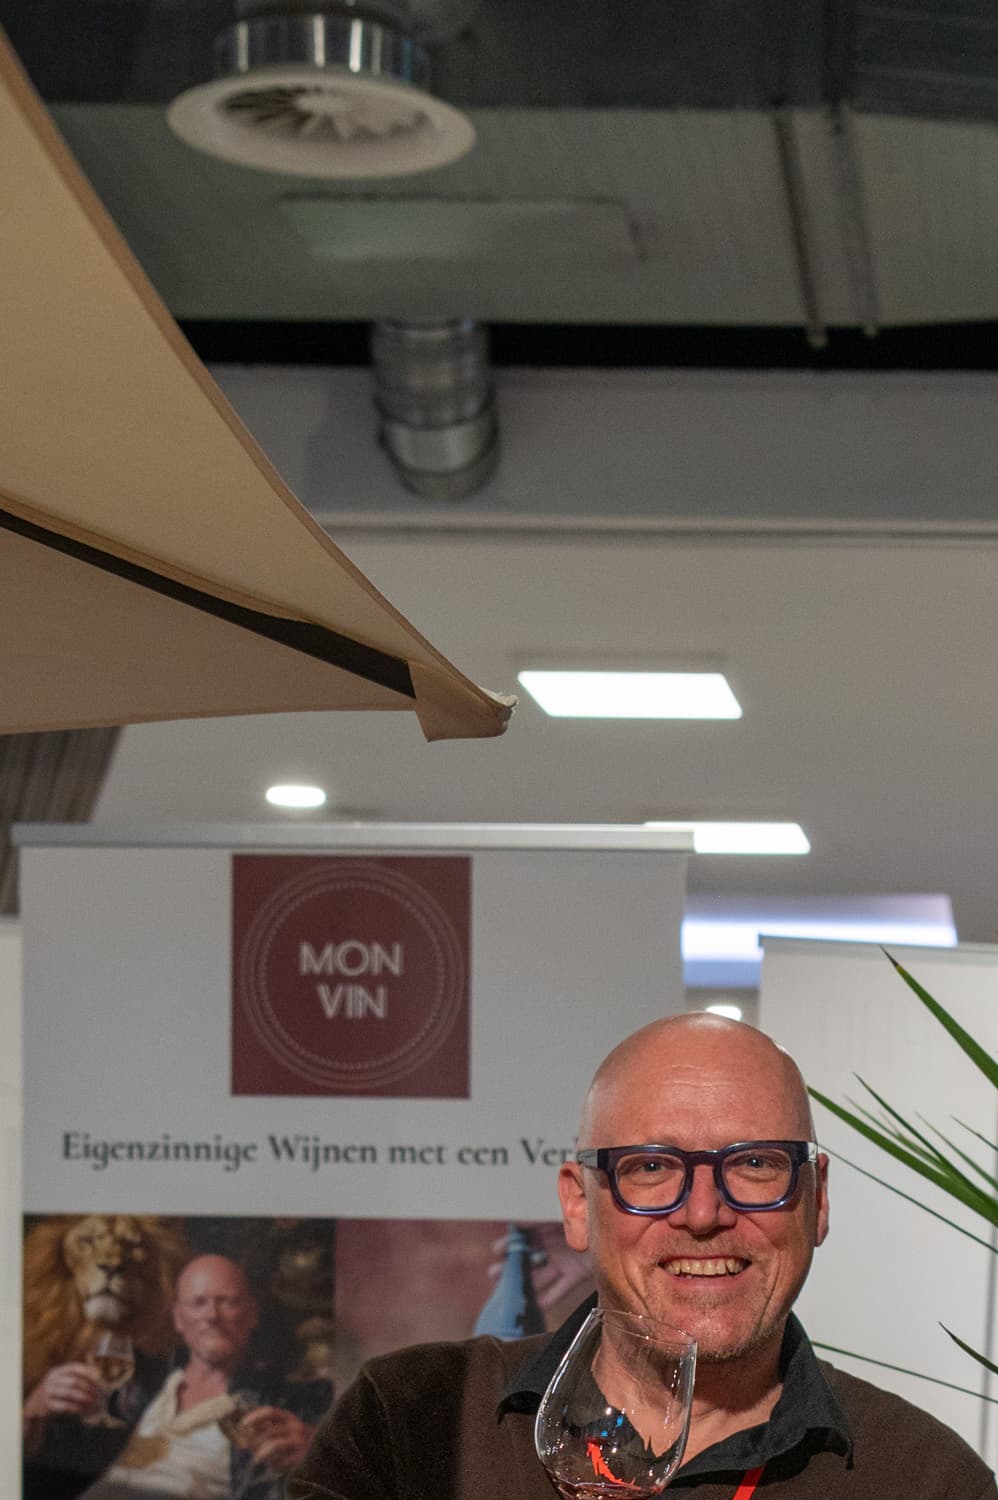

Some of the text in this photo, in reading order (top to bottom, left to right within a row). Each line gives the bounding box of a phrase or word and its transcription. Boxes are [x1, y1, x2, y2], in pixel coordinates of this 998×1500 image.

[300, 940, 404, 977] MON
[317, 984, 388, 1019] VIN
[62, 1131, 579, 1172] Eigenzinnige Wijnen met een Ver
